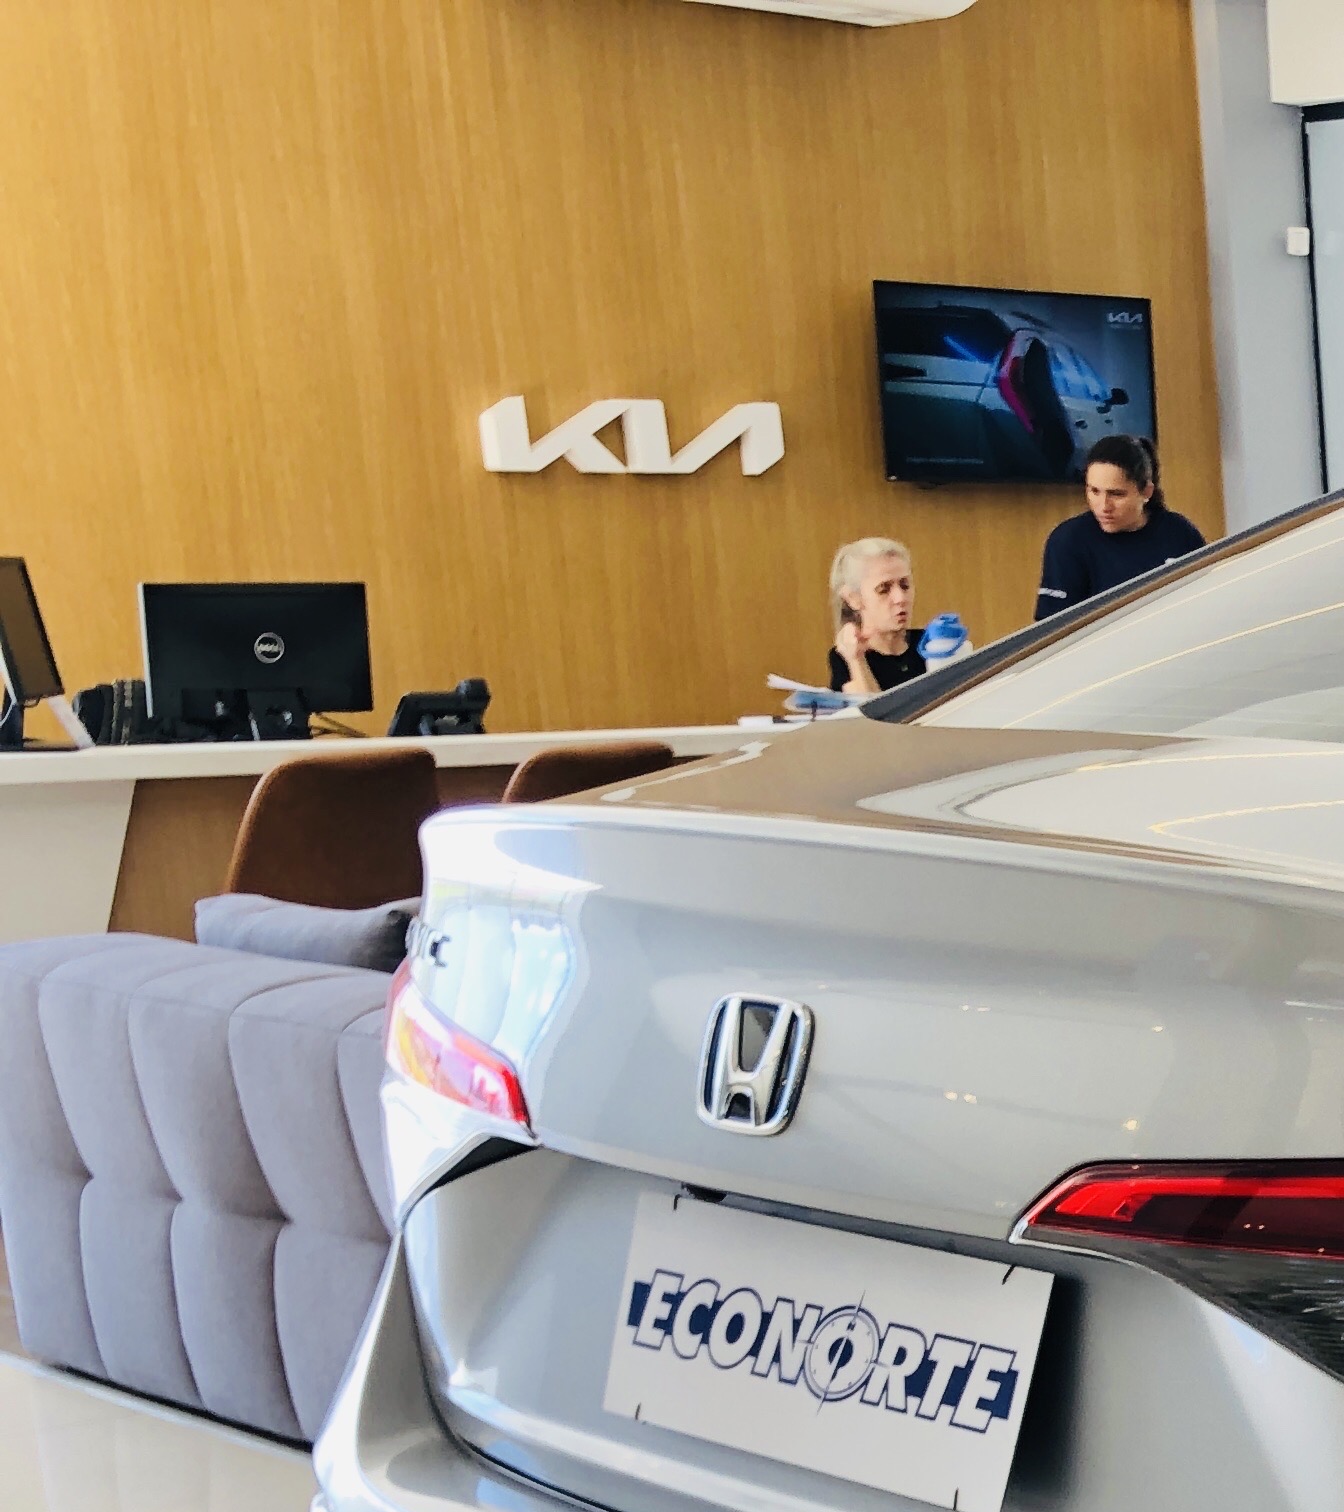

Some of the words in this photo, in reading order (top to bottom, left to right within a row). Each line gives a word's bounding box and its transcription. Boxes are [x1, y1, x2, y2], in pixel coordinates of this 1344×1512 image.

[1106, 311, 1143, 323] KIA
[479, 395, 785, 476] KIA
[631, 1268, 1019, 1435] ECONORTE
